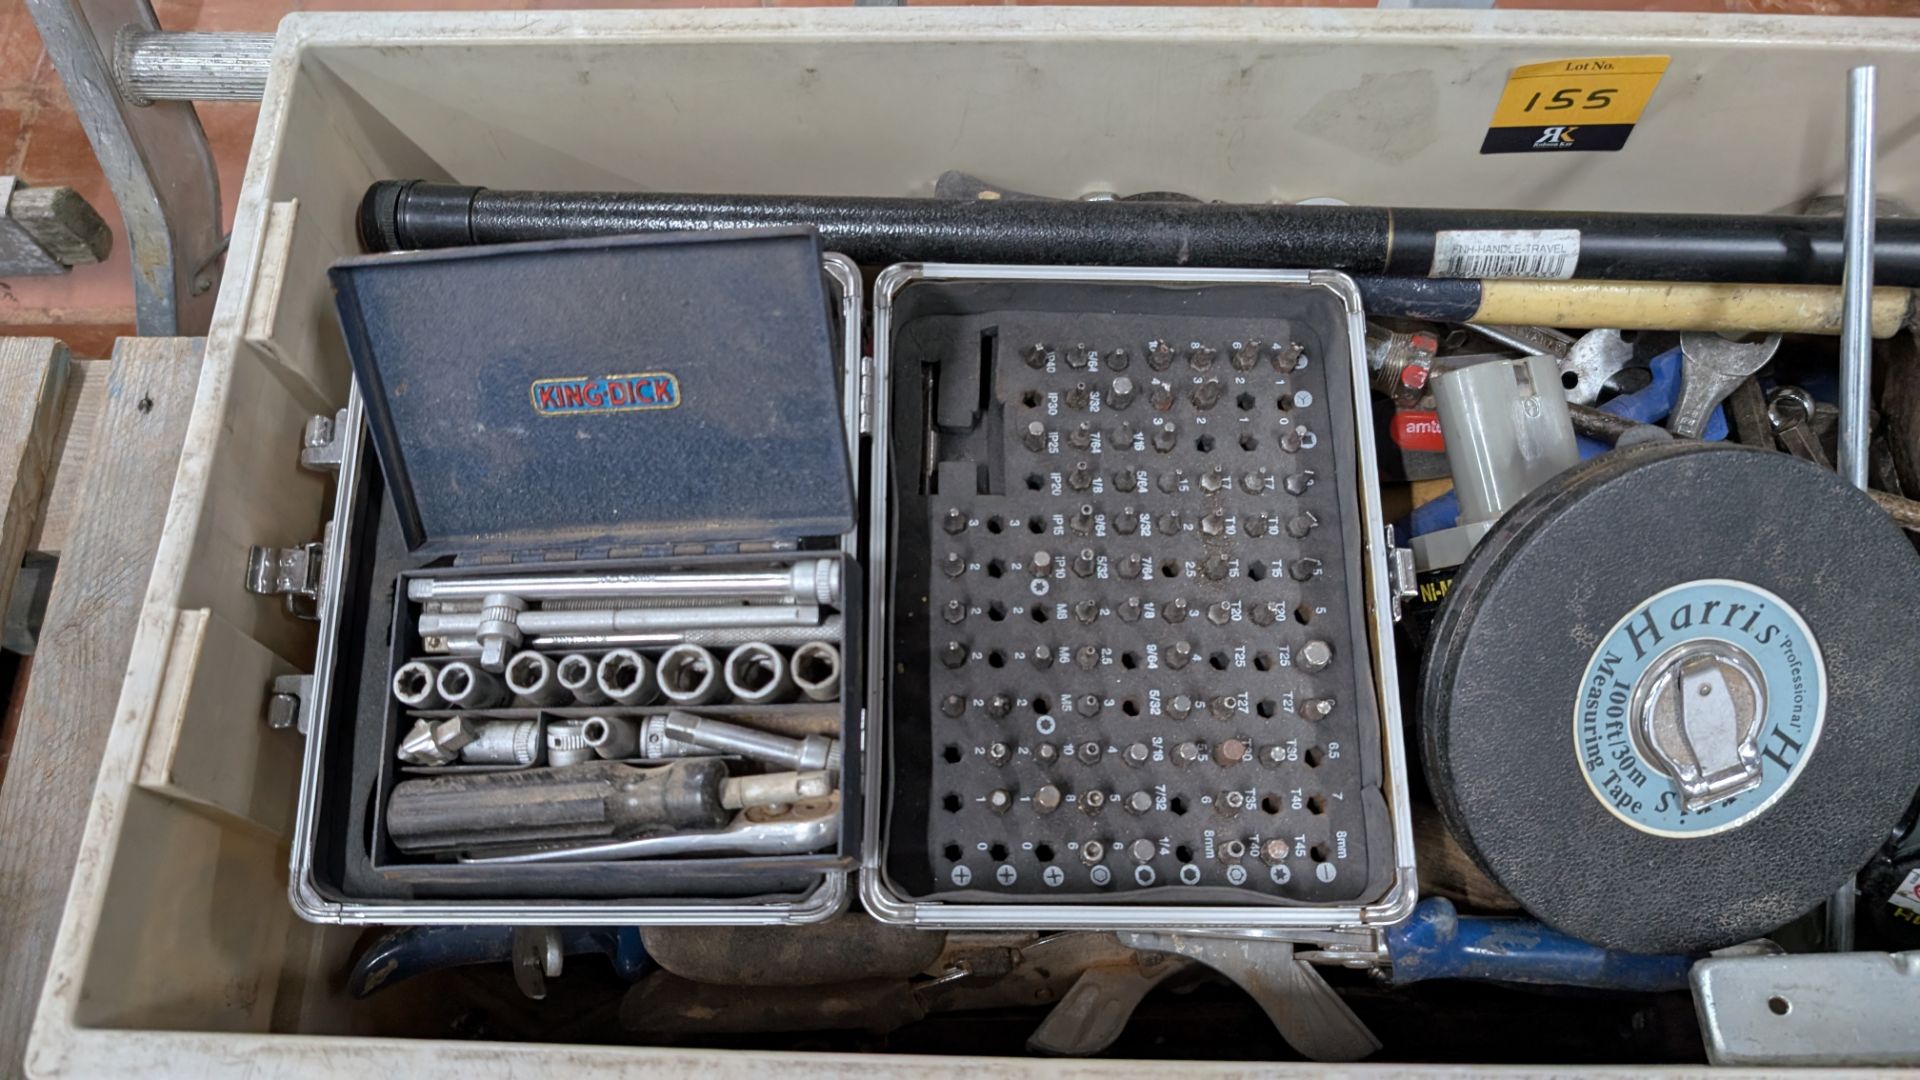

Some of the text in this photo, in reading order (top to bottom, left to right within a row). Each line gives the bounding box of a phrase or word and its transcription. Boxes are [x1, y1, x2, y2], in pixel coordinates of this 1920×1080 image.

[1565, 61, 1615, 72] Lot No.
[1524, 88, 1619, 112] 155
[1190, 342, 1200, 350] 8
[1232, 342, 1242, 350] 6
[1088, 351, 1098, 372] 5/64
[1151, 378, 1160, 386] 4
[1192, 376, 1203, 384] 3
[1235, 377, 1246, 385] 2
[1048, 392, 1058, 416] IP30
[1089, 391, 1100, 413] 3/32
[1153, 418, 1164, 426] 3
[1196, 417, 1207, 425] 2
[1048, 432, 1059, 454] IP25
[1090, 431, 1102, 454] 7/64
[1132, 431, 1145, 452] 1/16
[1050, 472, 1062, 496] IP20
[1092, 476, 1104, 494] 1/8
[1136, 470, 1148, 494] 5/64
[1222, 476, 1232, 490] T7
[1264, 475, 1276, 490] T7
[968, 519, 979, 527] 3
[1052, 514, 1064, 536] IP15
[1094, 514, 1106, 537] 9/64
[1139, 512, 1152, 537] 3/32
[1183, 523, 1194, 532] 2
[1224, 516, 1236, 536] T10
[1268, 516, 1280, 536] T10
[1011, 562, 1022, 570] 2
[1054, 556, 1066, 580] IP10
[1096, 555, 1109, 580] 5/32
[1142, 556, 1154, 581] 7/64
[1184, 561, 1196, 578] 2.5
[1228, 559, 1240, 578] T15
[1272, 559, 1282, 578] T15
[1056, 603, 1068, 620] M8
[1100, 608, 1111, 616] 2
[1143, 602, 1156, 619] 1/8
[1188, 609, 1200, 617] 3
[1230, 600, 1242, 622] T20
[1275, 600, 1286, 622] T20
[1315, 606, 1326, 614] 5
[1624, 600, 1780, 662] Harris
[972, 652, 983, 660] 2
[1014, 652, 1026, 660] 2
[1058, 646, 1070, 664] M6
[1100, 648, 1113, 665] 2.5
[1146, 644, 1158, 670] 9/64
[1192, 654, 1202, 662] 4
[1234, 645, 1246, 668] T25
[1279, 645, 1290, 667] T25
[972, 698, 984, 707] 2
[1016, 698, 1028, 707] 2
[1060, 694, 1072, 712] M5
[1103, 698, 1116, 707] 3
[1148, 689, 1161, 716] 5/32
[1194, 700, 1206, 709] 5
[1238, 691, 1249, 714] T27
[1282, 690, 1294, 714] T27
[1584, 650, 1643, 814] Measuring Tape
[1606, 680, 1648, 789] 100ft/30m
[974, 746, 986, 755] 2
[1018, 746, 1030, 755] 2
[1063, 744, 1074, 756] 10
[1107, 746, 1118, 754] 4
[1152, 736, 1164, 762] 3/16
[1286, 738, 1298, 761] T30
[1328, 742, 1340, 760] 6.5
[1065, 794, 1076, 802] 8
[1109, 794, 1121, 802] 5
[1154, 784, 1168, 811] 7/32
[1200, 795, 1212, 804] 6
[1244, 787, 1257, 810] T35
[1290, 787, 1302, 810] T40
[1332, 792, 1343, 800] 7
[976, 842, 988, 850] 0
[1022, 842, 1033, 850] 0
[1112, 842, 1124, 850] 6
[1158, 836, 1170, 856] 1/4
[1204, 829, 1215, 859] 8mm
[1248, 834, 1260, 857] T40
[1294, 834, 1306, 858] T45
[1336, 830, 1348, 859] 8mm
